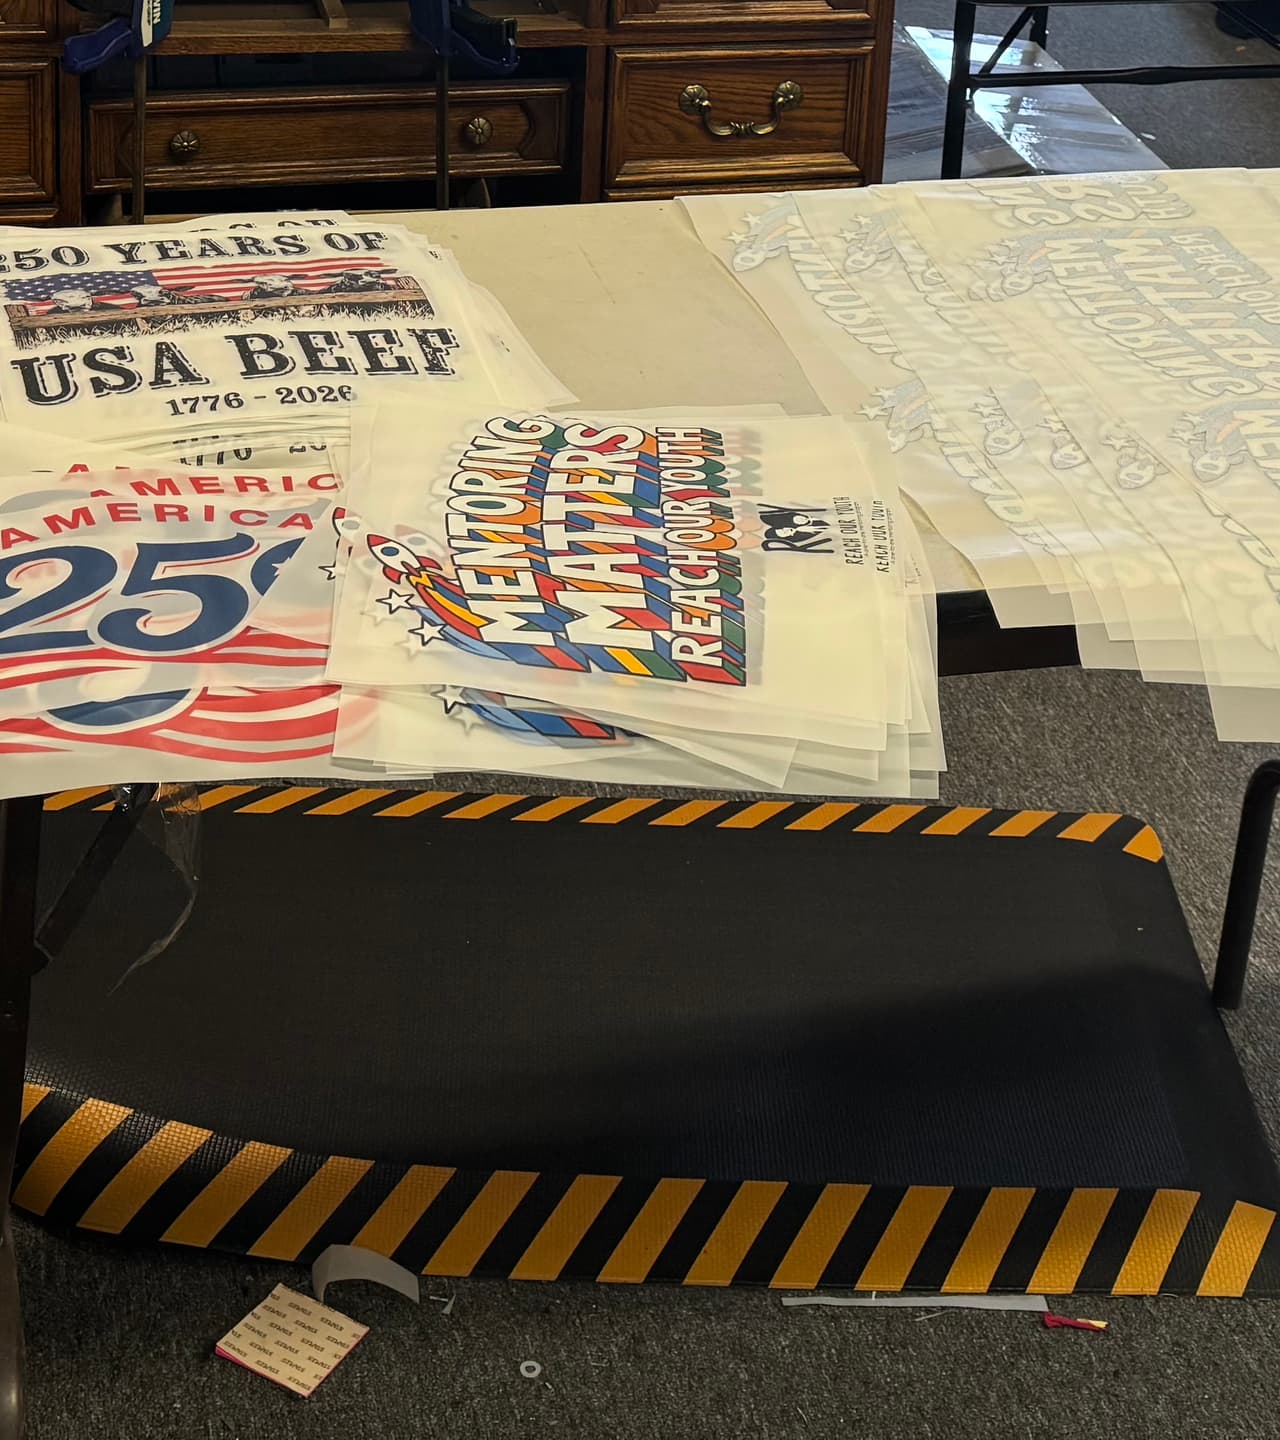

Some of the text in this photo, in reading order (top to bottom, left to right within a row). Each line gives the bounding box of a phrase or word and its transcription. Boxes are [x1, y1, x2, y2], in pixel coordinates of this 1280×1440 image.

[103, 233, 311, 265] YEARS
[323, 231, 389, 253] OF
[10, 340, 211, 406] USA
[224, 327, 460, 380] BEEF
[166, 391, 245, 416] 1776
[275, 384, 352, 405] 2026
[0, 502, 314, 550] AMERICA
[445, 414, 563, 647] MENTORING
[546, 418, 656, 652] MATTERS
[655, 426, 723, 667] REACH OUR YOUTH
[838, 517, 858, 536] OUR
[840, 536, 864, 565] REACH
